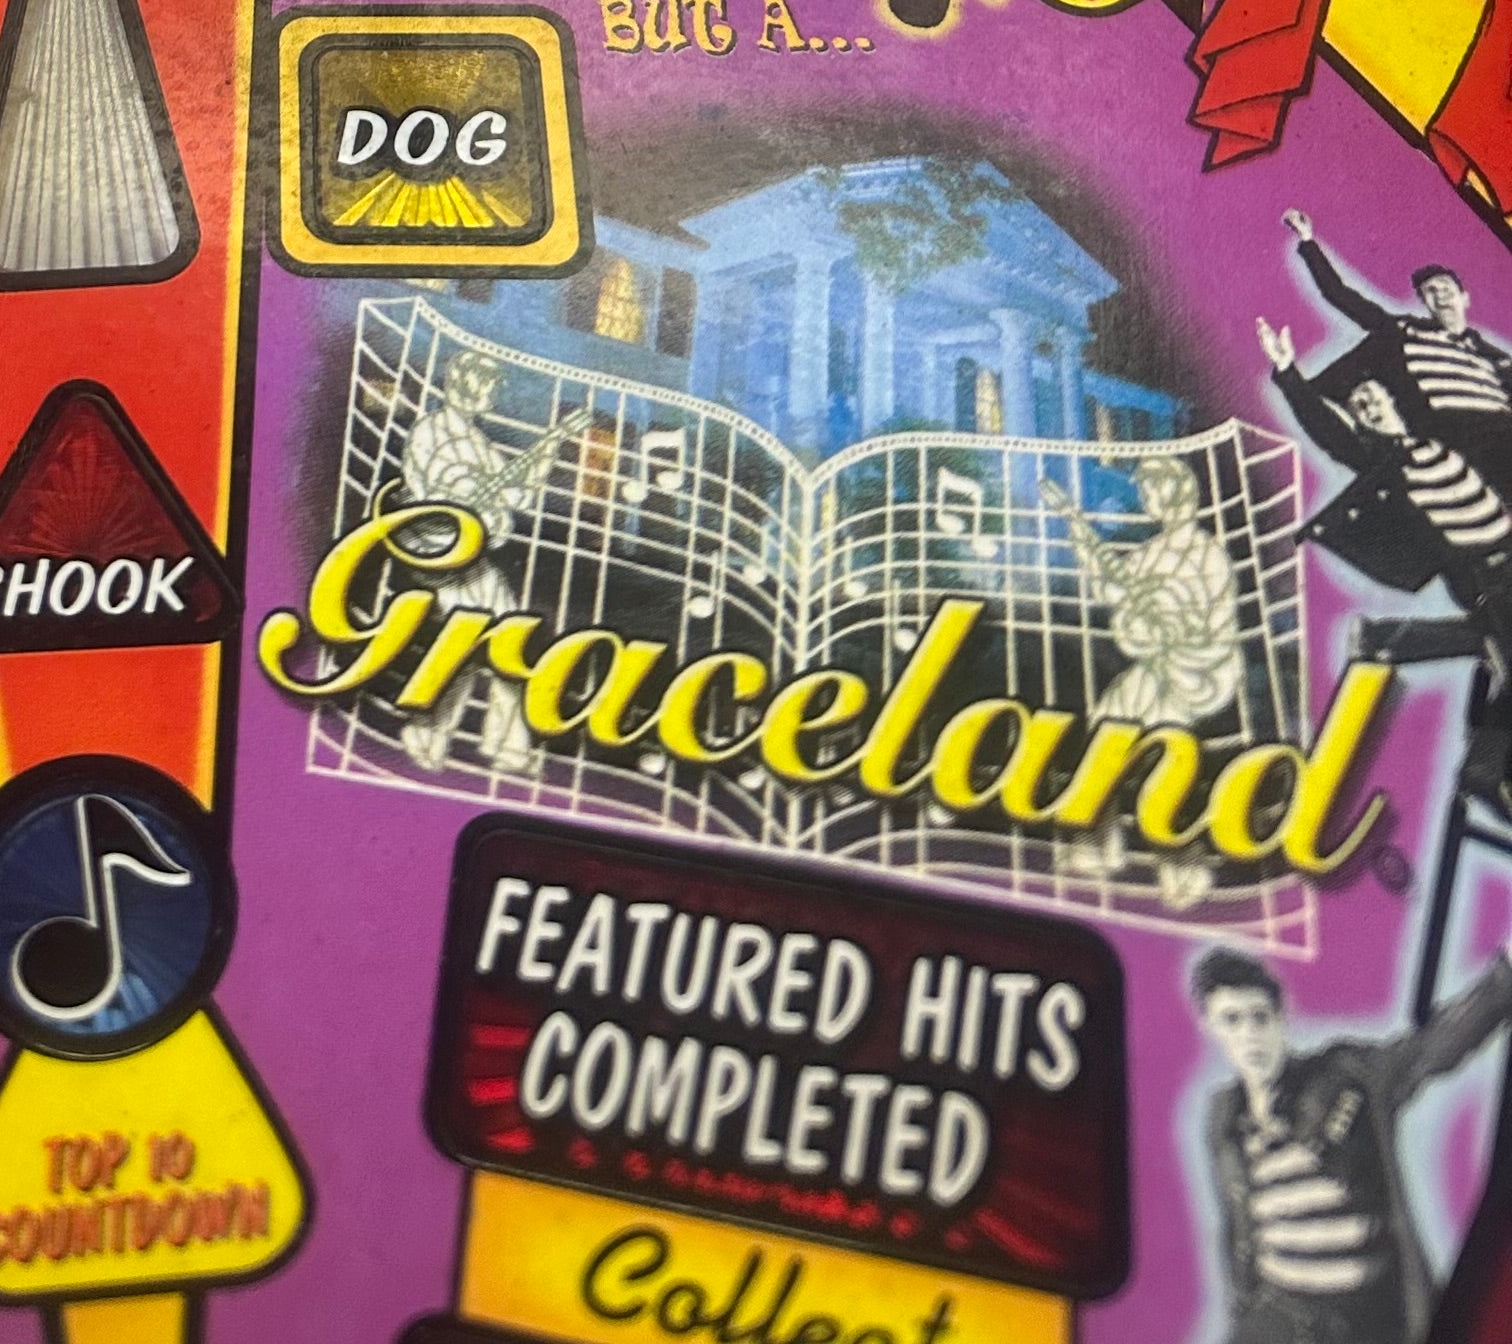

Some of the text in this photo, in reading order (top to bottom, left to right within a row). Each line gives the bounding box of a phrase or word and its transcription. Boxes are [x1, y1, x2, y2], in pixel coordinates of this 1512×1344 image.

[336, 109, 509, 167] DOG
[258, 476, 1396, 872] Graceland
[475, 876, 1088, 1092] FEATURED HITS
[43, 1130, 197, 1195] TOP 10
[520, 1010, 988, 1206] COMPLETED
